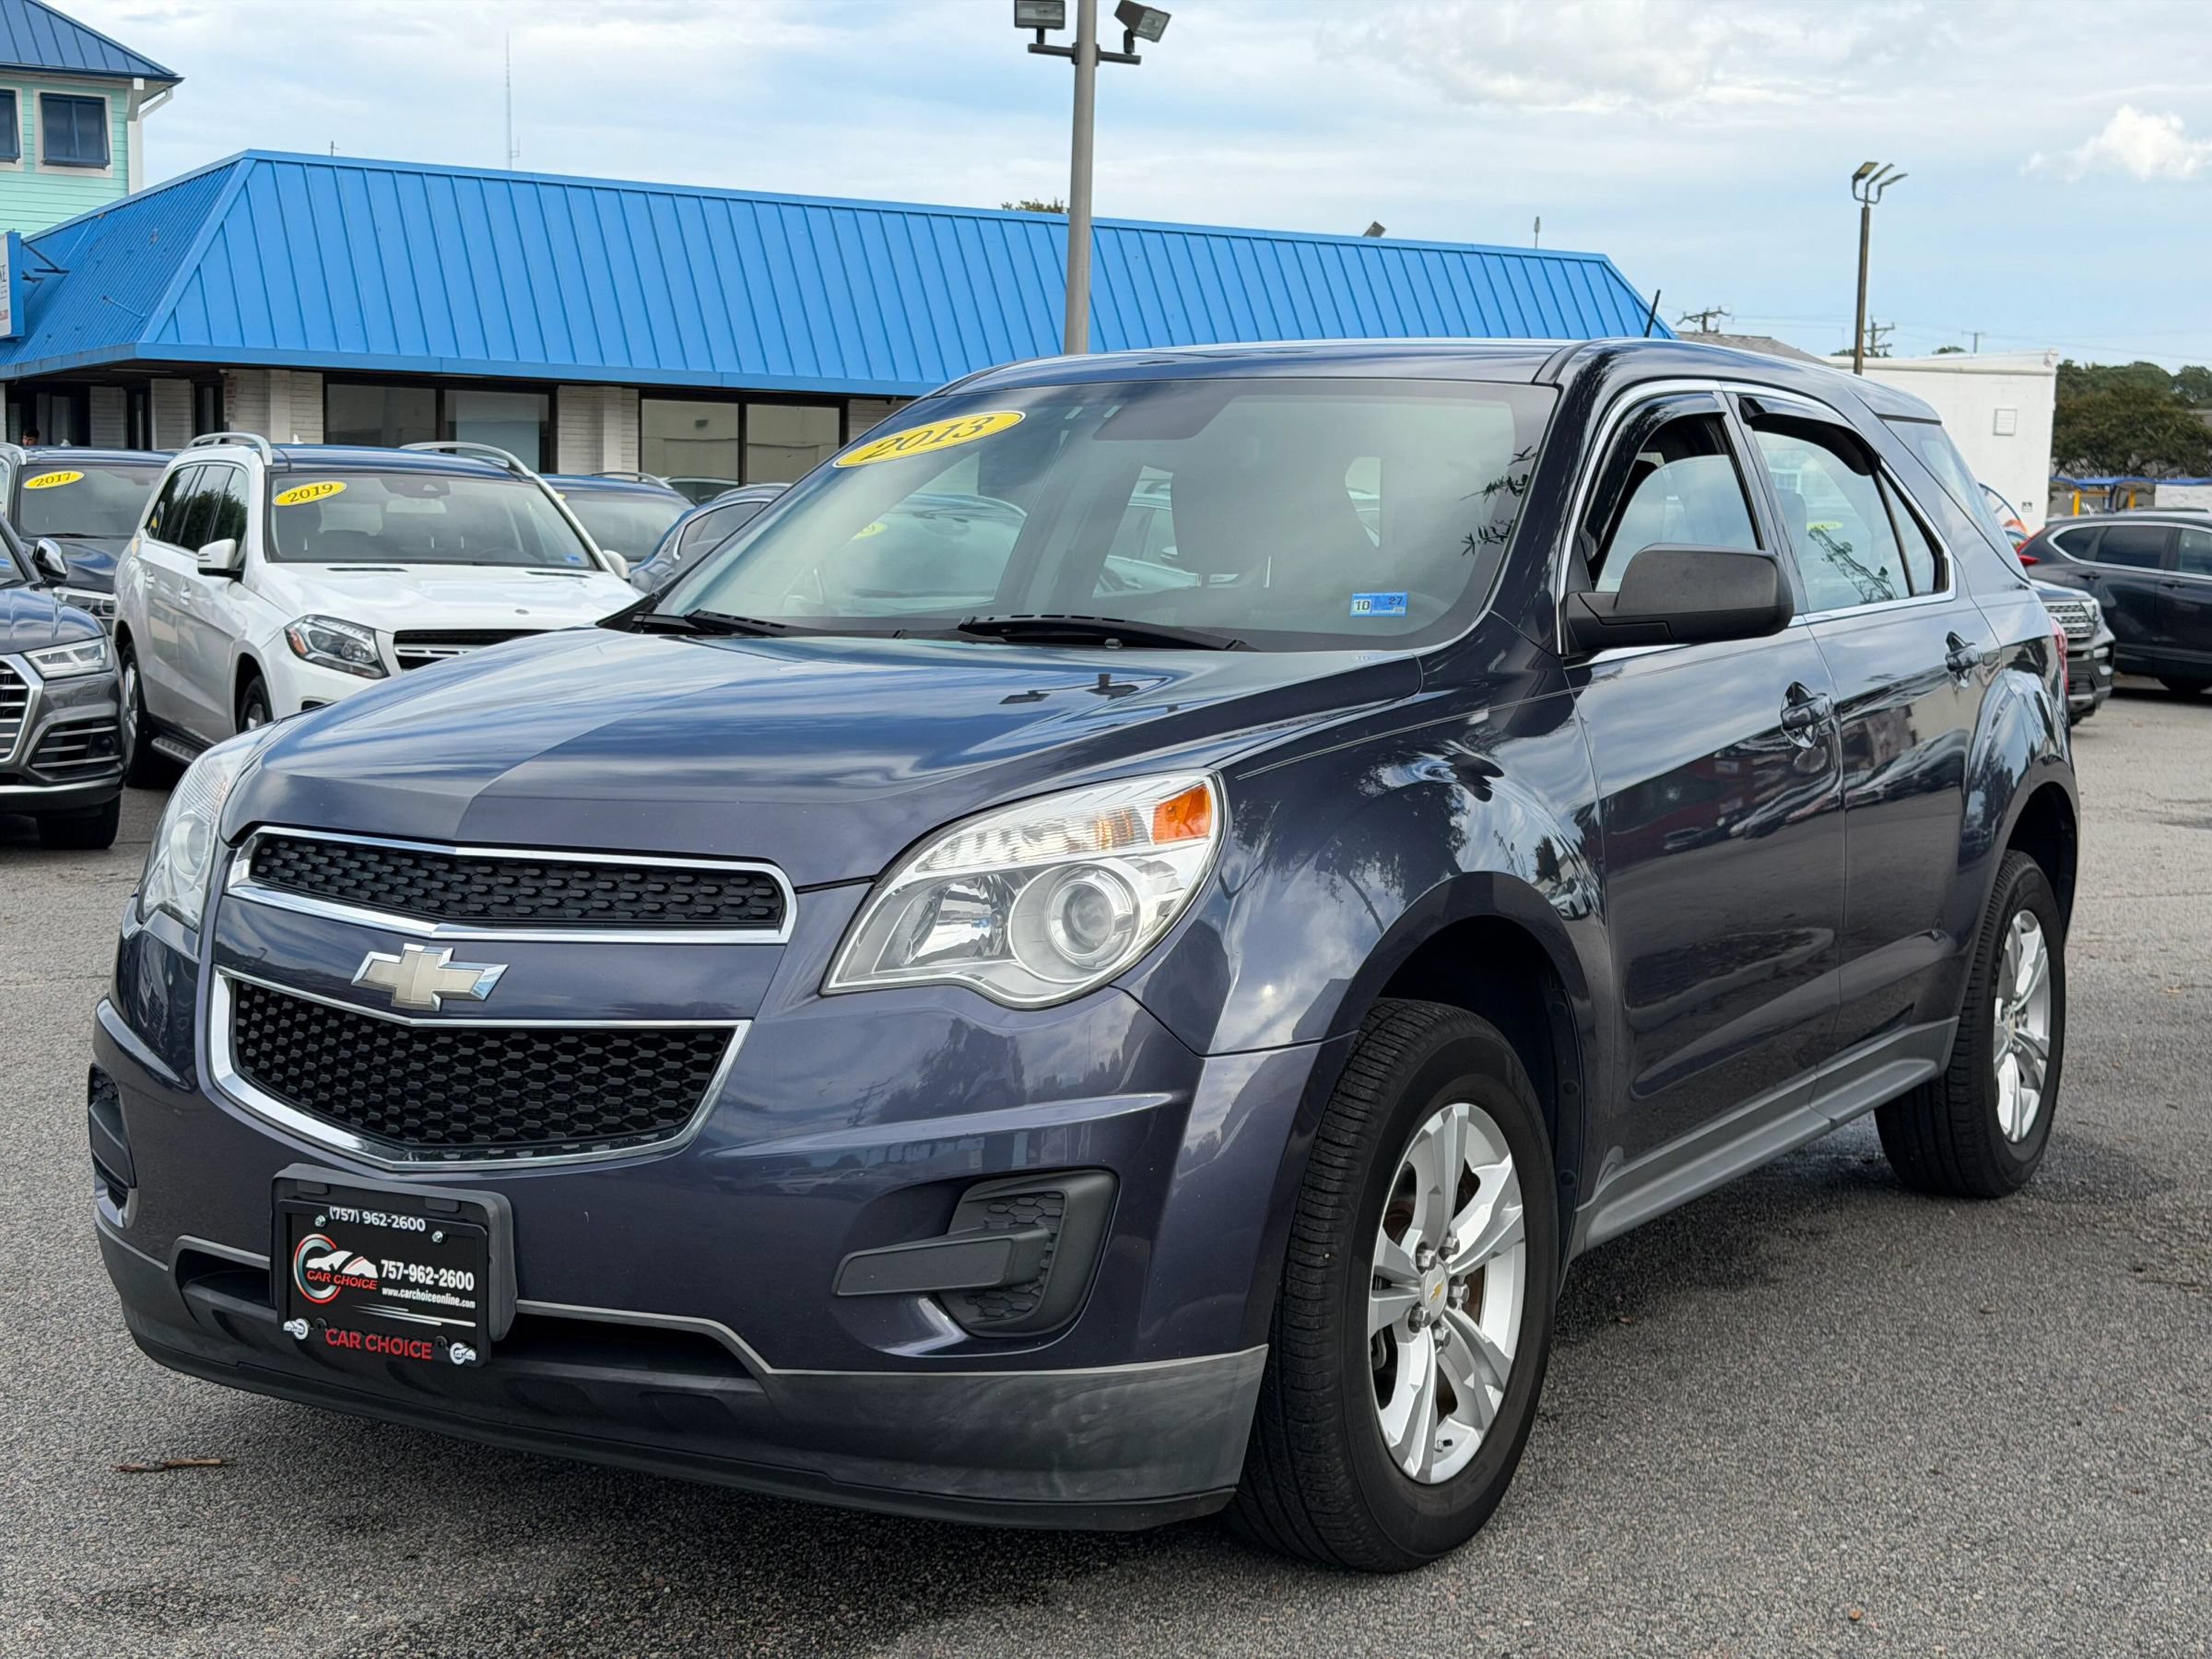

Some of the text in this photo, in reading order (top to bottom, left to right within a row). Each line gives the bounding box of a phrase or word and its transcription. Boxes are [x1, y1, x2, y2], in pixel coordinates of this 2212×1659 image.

[859, 416, 994, 462] 2013
[35, 472, 71, 488] 2017
[288, 483, 334, 503] 2019
[1355, 600, 1371, 611] 10
[329, 1206, 426, 1232] (757) 962-2600
[306, 1270, 378, 1290] CAR CHOICE
[381, 1259, 475, 1291] 757-962-2600
[382, 1288, 476, 1309] www.carchoiceonline.com
[325, 1328, 433, 1360] CAR CHOICE
